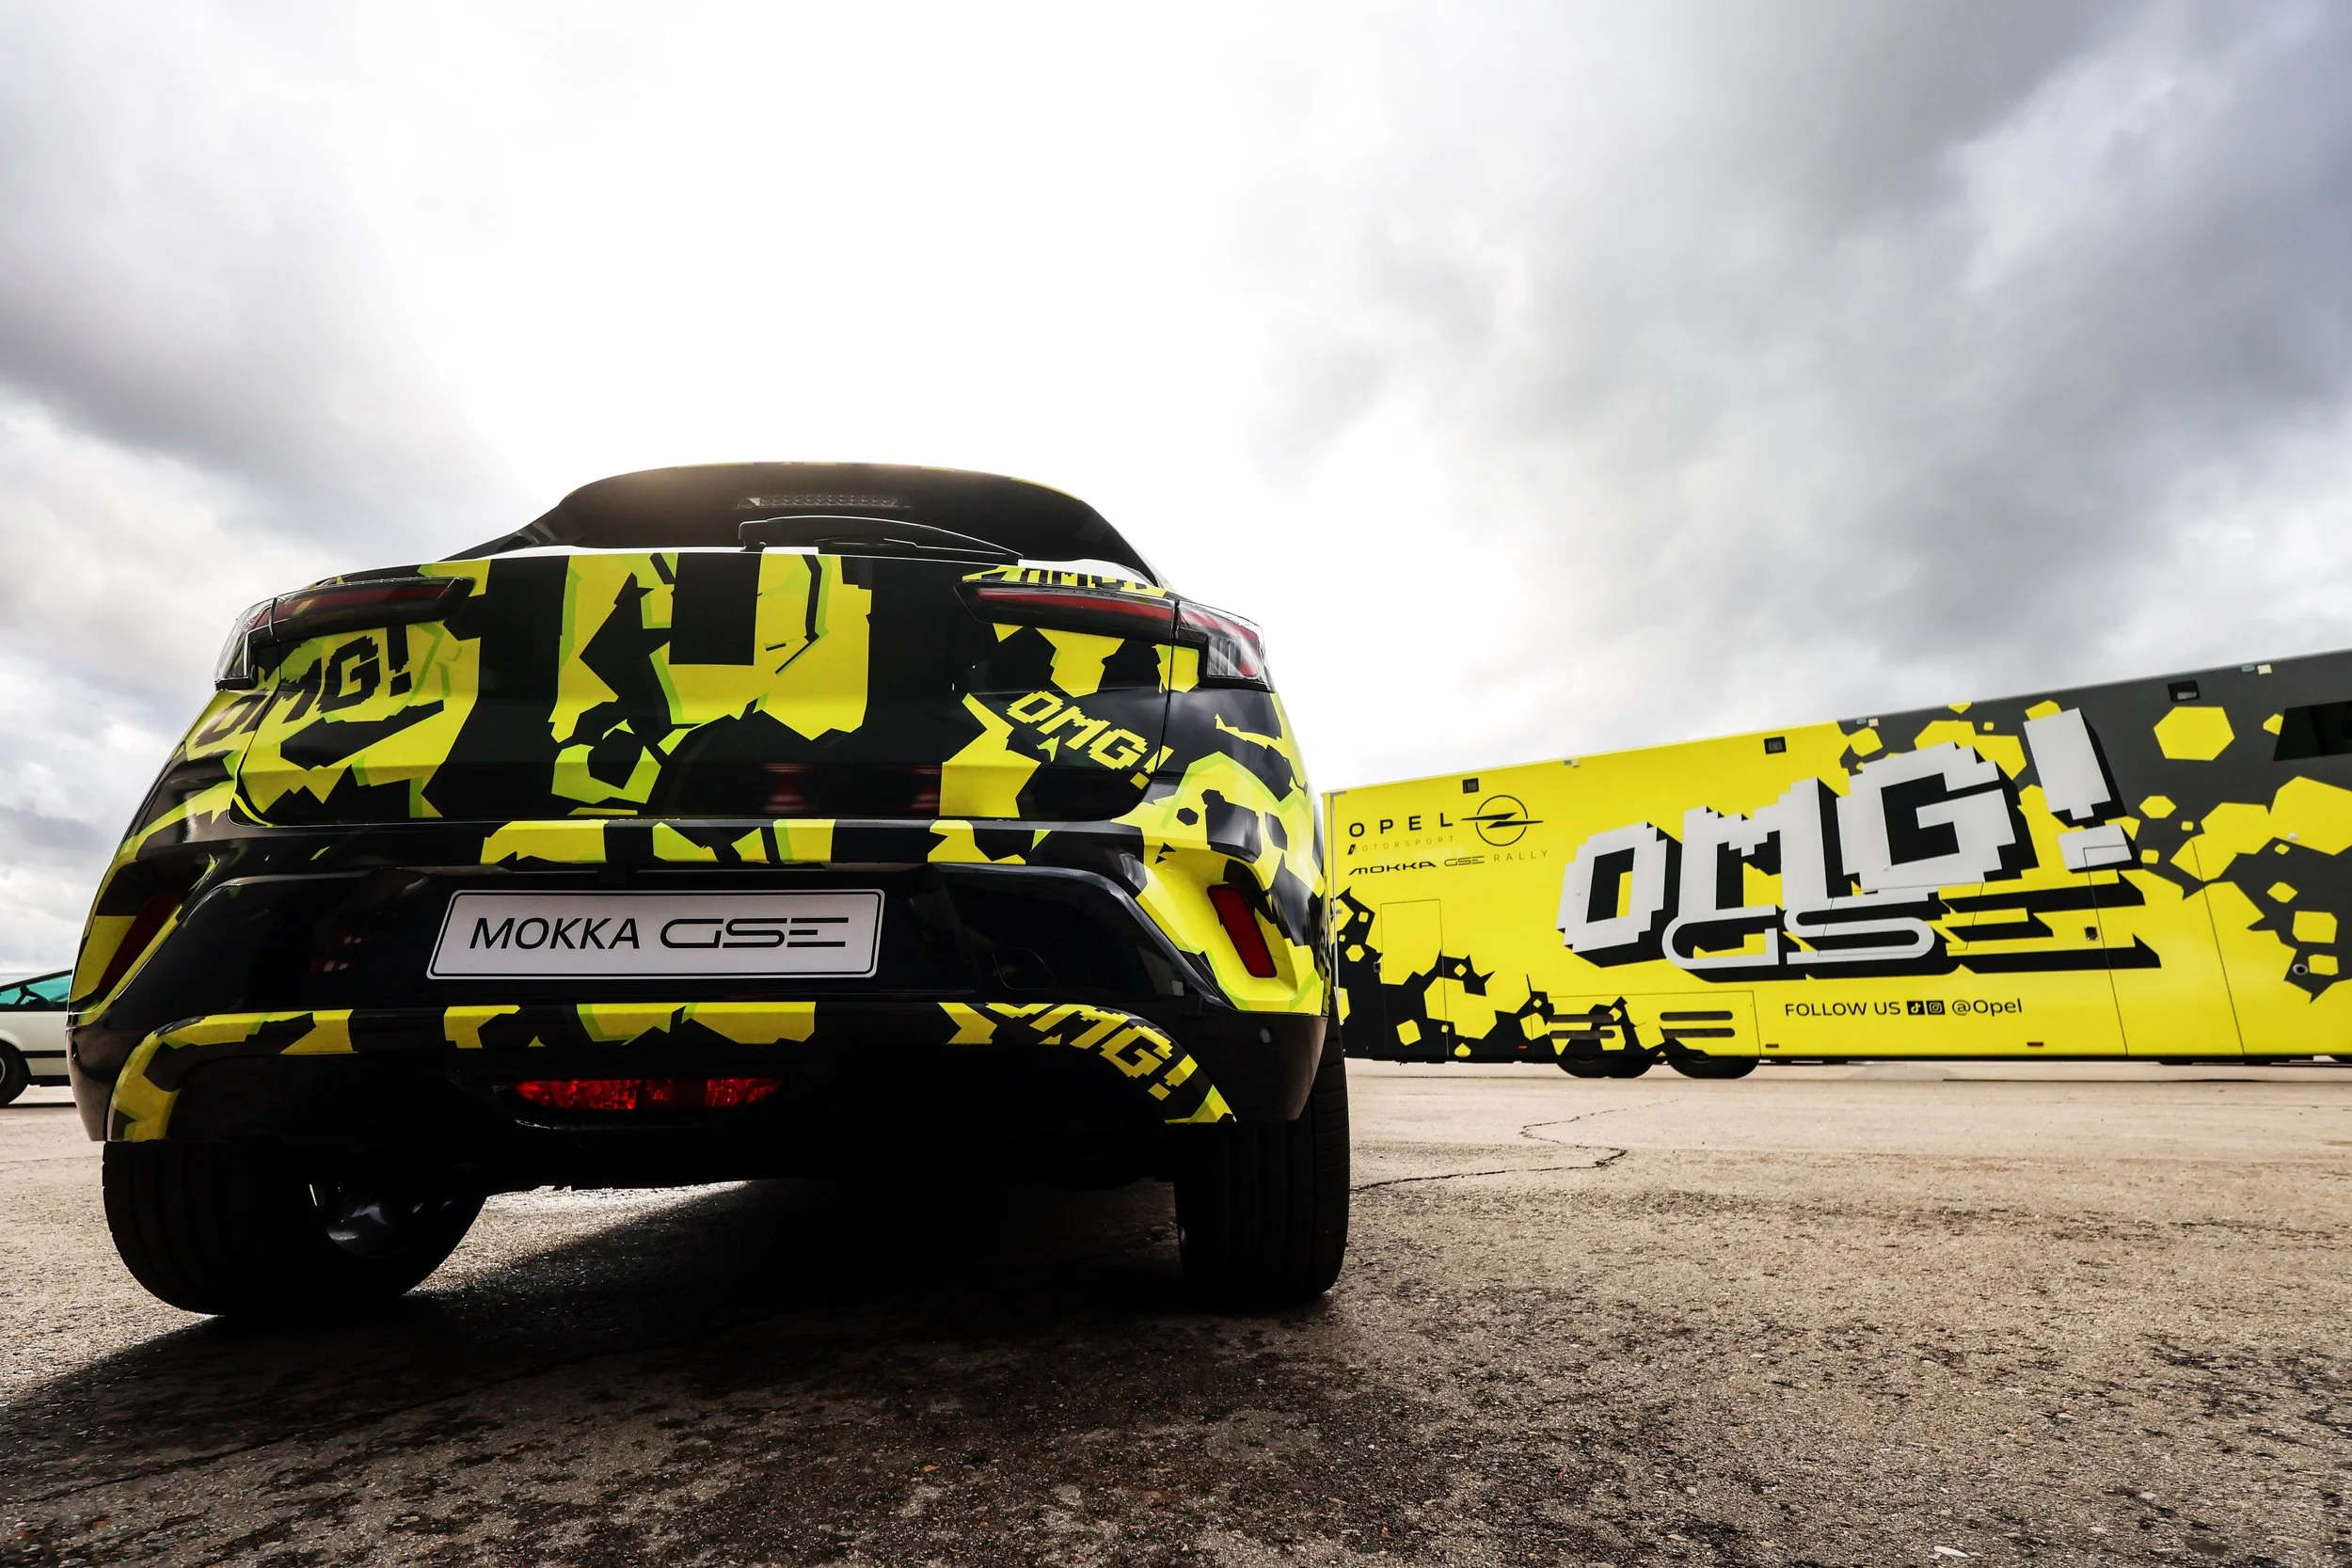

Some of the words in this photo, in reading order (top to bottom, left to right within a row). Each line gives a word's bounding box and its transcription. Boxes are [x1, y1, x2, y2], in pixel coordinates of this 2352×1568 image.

[195, 626, 413, 749] OMG!
[1006, 690, 1175, 790] OMG!
[1348, 812, 1454, 837] OPEL
[1556, 707, 2143, 968] OMG!
[1348, 861, 1437, 876] MOKKA
[1444, 855, 1486, 867] GSE
[1493, 849, 1549, 863] RALLY
[469, 917, 641, 950] MOKKA
[659, 917, 850, 949] GSE
[1785, 1002, 1867, 1017] FOLLOW
[1874, 1001, 1901, 1016] US
[1951, 997, 2023, 1017] @Opel
